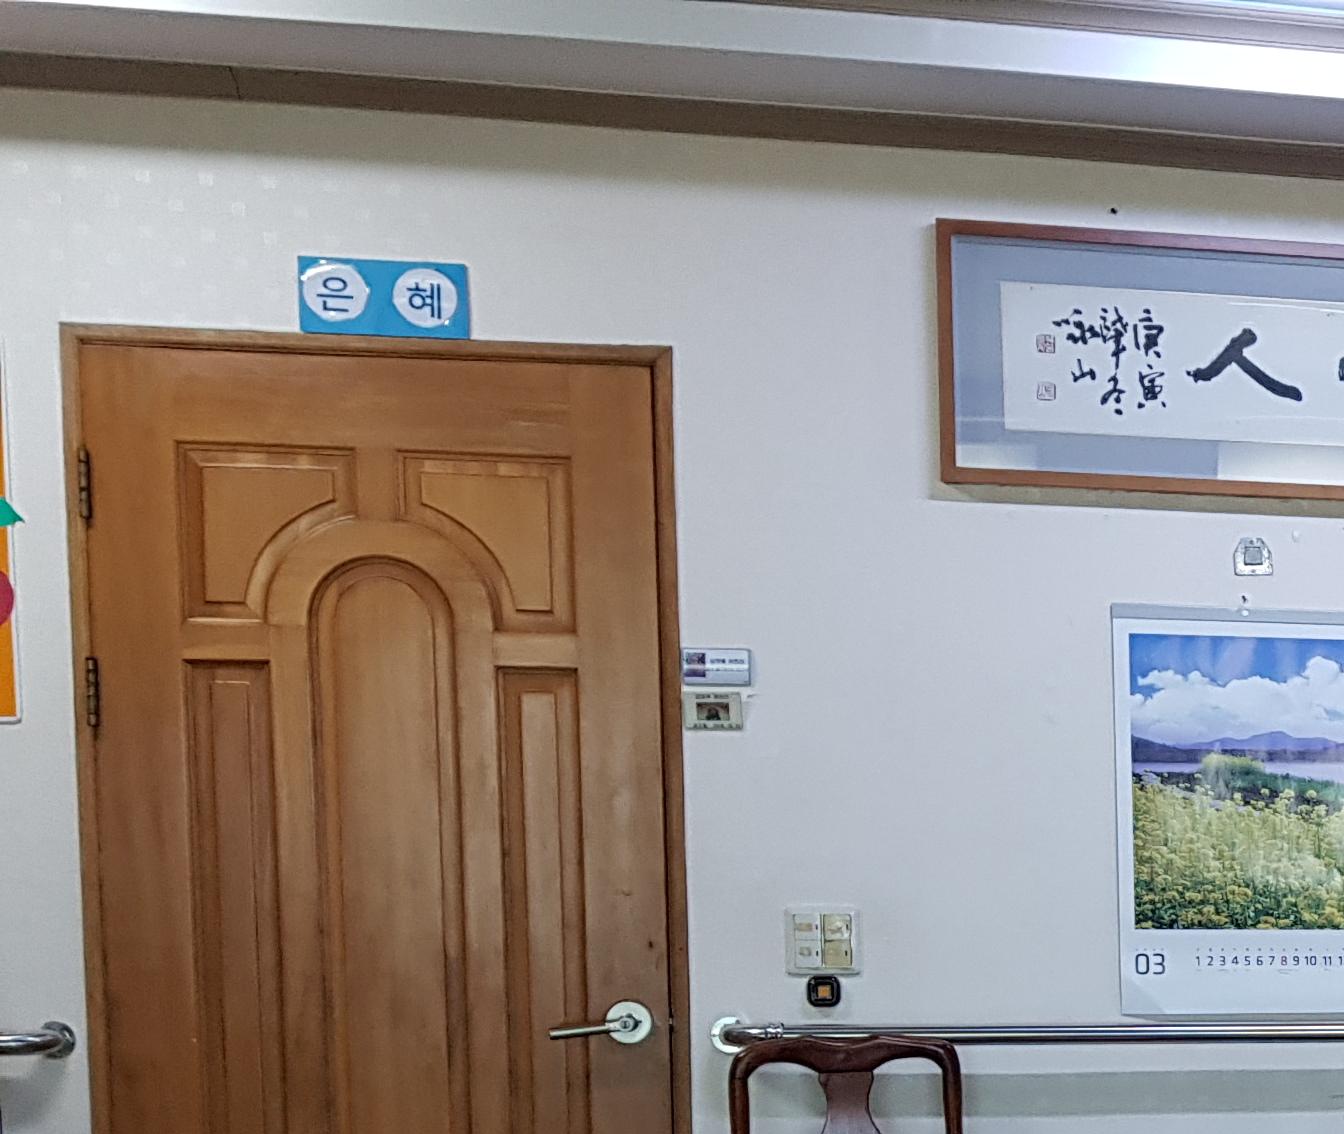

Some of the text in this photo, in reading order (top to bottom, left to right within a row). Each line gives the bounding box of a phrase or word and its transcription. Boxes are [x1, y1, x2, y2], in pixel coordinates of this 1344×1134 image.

[1135, 953, 1166, 975] 03
[1195, 956, 1200, 966] 1
[1207, 956, 1213, 966] 2
[1219, 956, 1226, 966] 3
[1231, 956, 1239, 966] 4
[1244, 956, 1250, 966] 5
[1256, 956, 1263, 966] 6
[1268, 956, 1275, 966] 7
[1281, 956, 1287, 966] 8
[1293, 956, 1299, 966] 9
[1305, 956, 1317, 966] 10
[1322, 956, 1332, 966] 11
